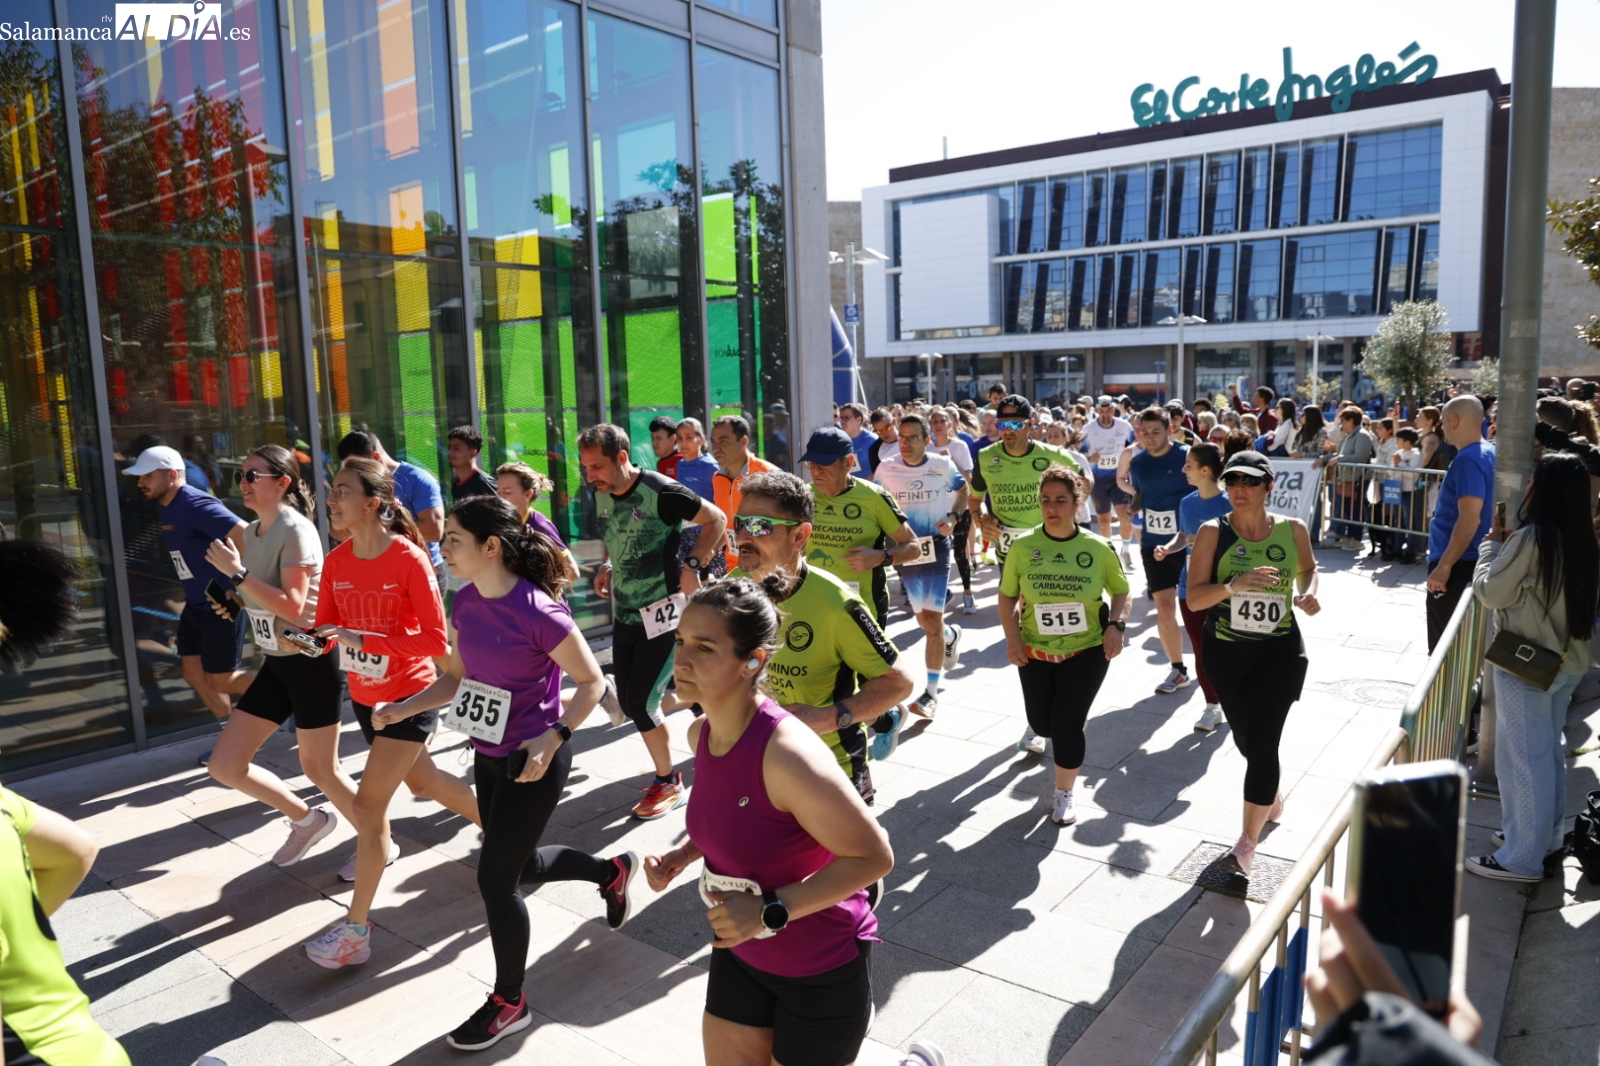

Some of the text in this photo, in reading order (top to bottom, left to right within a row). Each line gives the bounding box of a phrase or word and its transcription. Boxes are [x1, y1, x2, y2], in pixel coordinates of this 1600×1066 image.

[1130, 40, 1439, 128] El Corte Inglés
[1100, 457, 1117, 466] 279
[1148, 514, 1172, 529] 212
[812, 540, 845, 549] SALAMANCA
[1027, 573, 1092, 584] CORRECAMINOS
[1032, 582, 1083, 592] CARBAJOSA
[655, 603, 679, 624] 42
[1041, 611, 1081, 627] 515
[1238, 600, 1280, 623] 430
[858, 612, 889, 654] CARBAJOSA
[455, 690, 502, 727] 355
